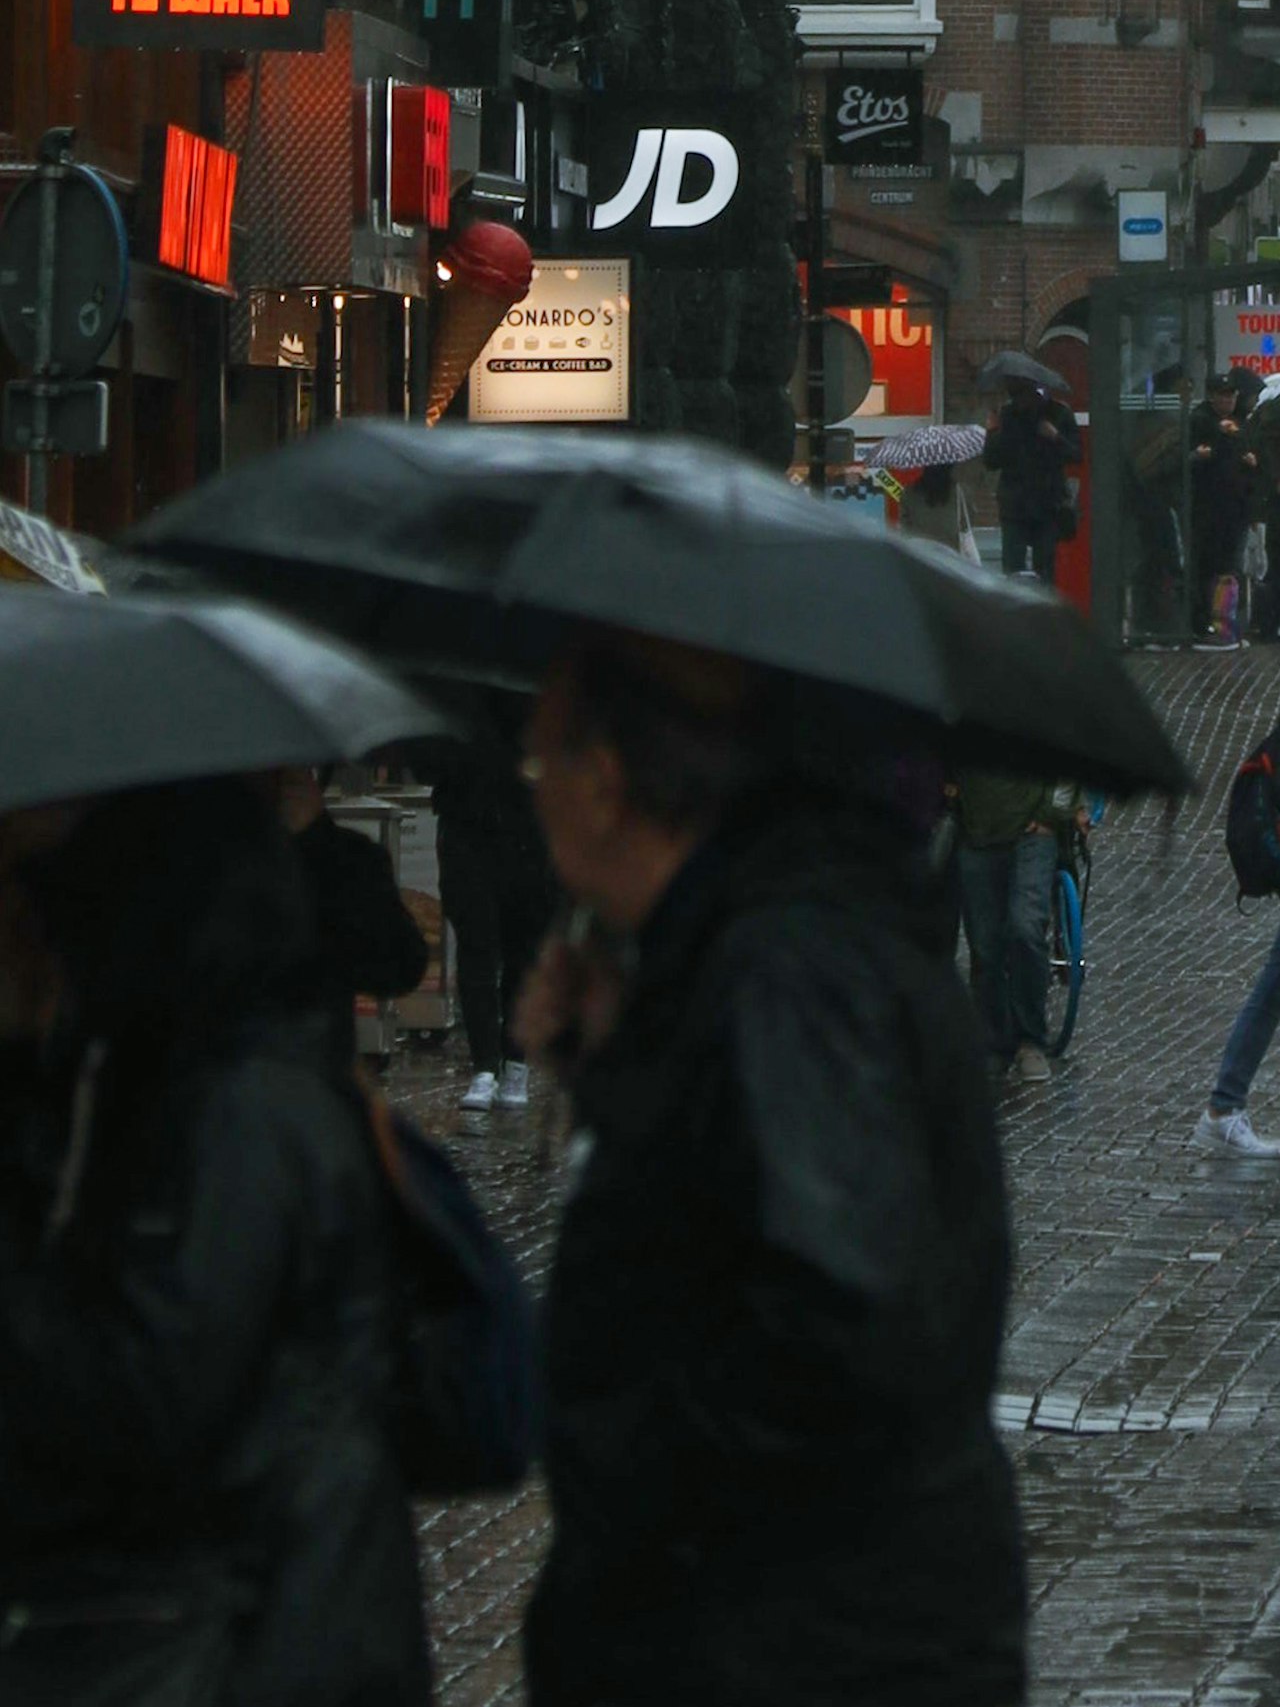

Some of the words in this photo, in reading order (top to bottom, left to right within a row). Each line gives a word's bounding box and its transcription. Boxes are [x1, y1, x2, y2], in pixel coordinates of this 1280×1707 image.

[836, 85, 910, 127] Etos
[592, 127, 741, 230] JD
[490, 360, 541, 371] ICE-CREAM
[552, 360, 587, 371] COFFEE
[588, 360, 608, 370] BAR
